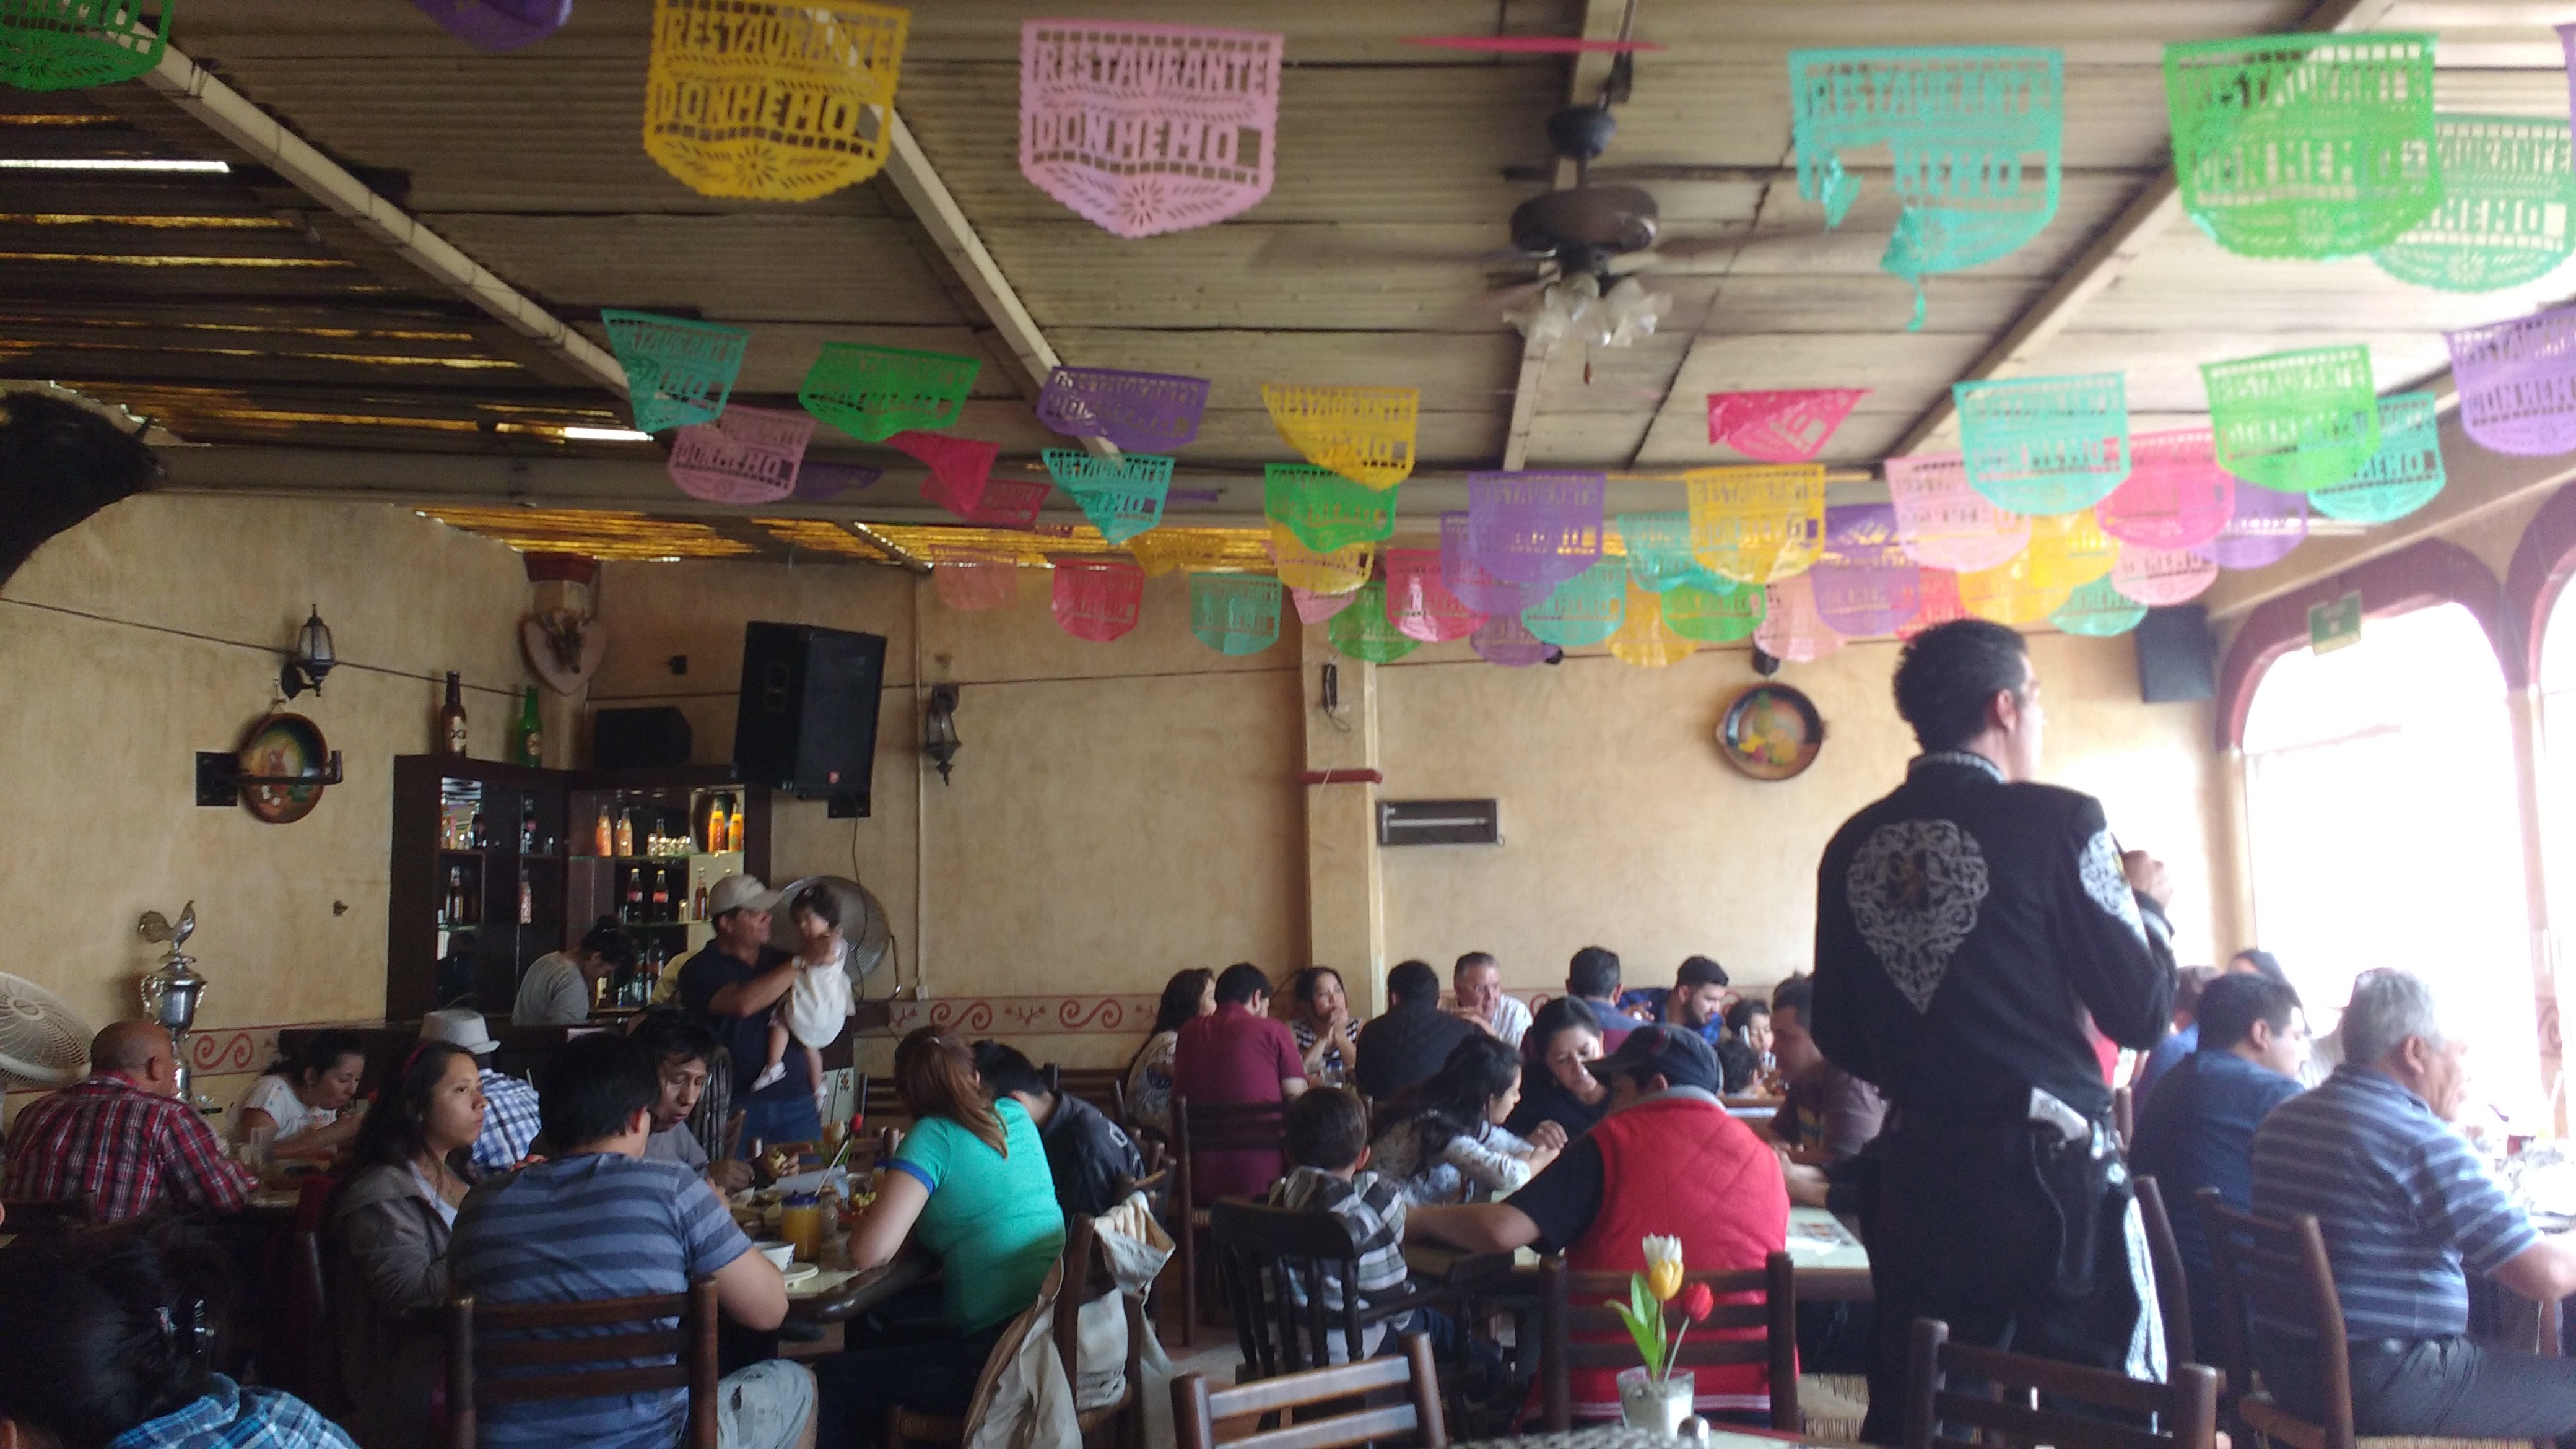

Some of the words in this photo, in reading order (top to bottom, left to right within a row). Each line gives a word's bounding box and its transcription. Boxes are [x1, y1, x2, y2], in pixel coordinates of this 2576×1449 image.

[664, 12, 892, 70] RESTAURANTE
[1037, 45, 1268, 97] RESTAURANTE
[659, 82, 731, 124] DON
[1036, 113, 1107, 153] DON
